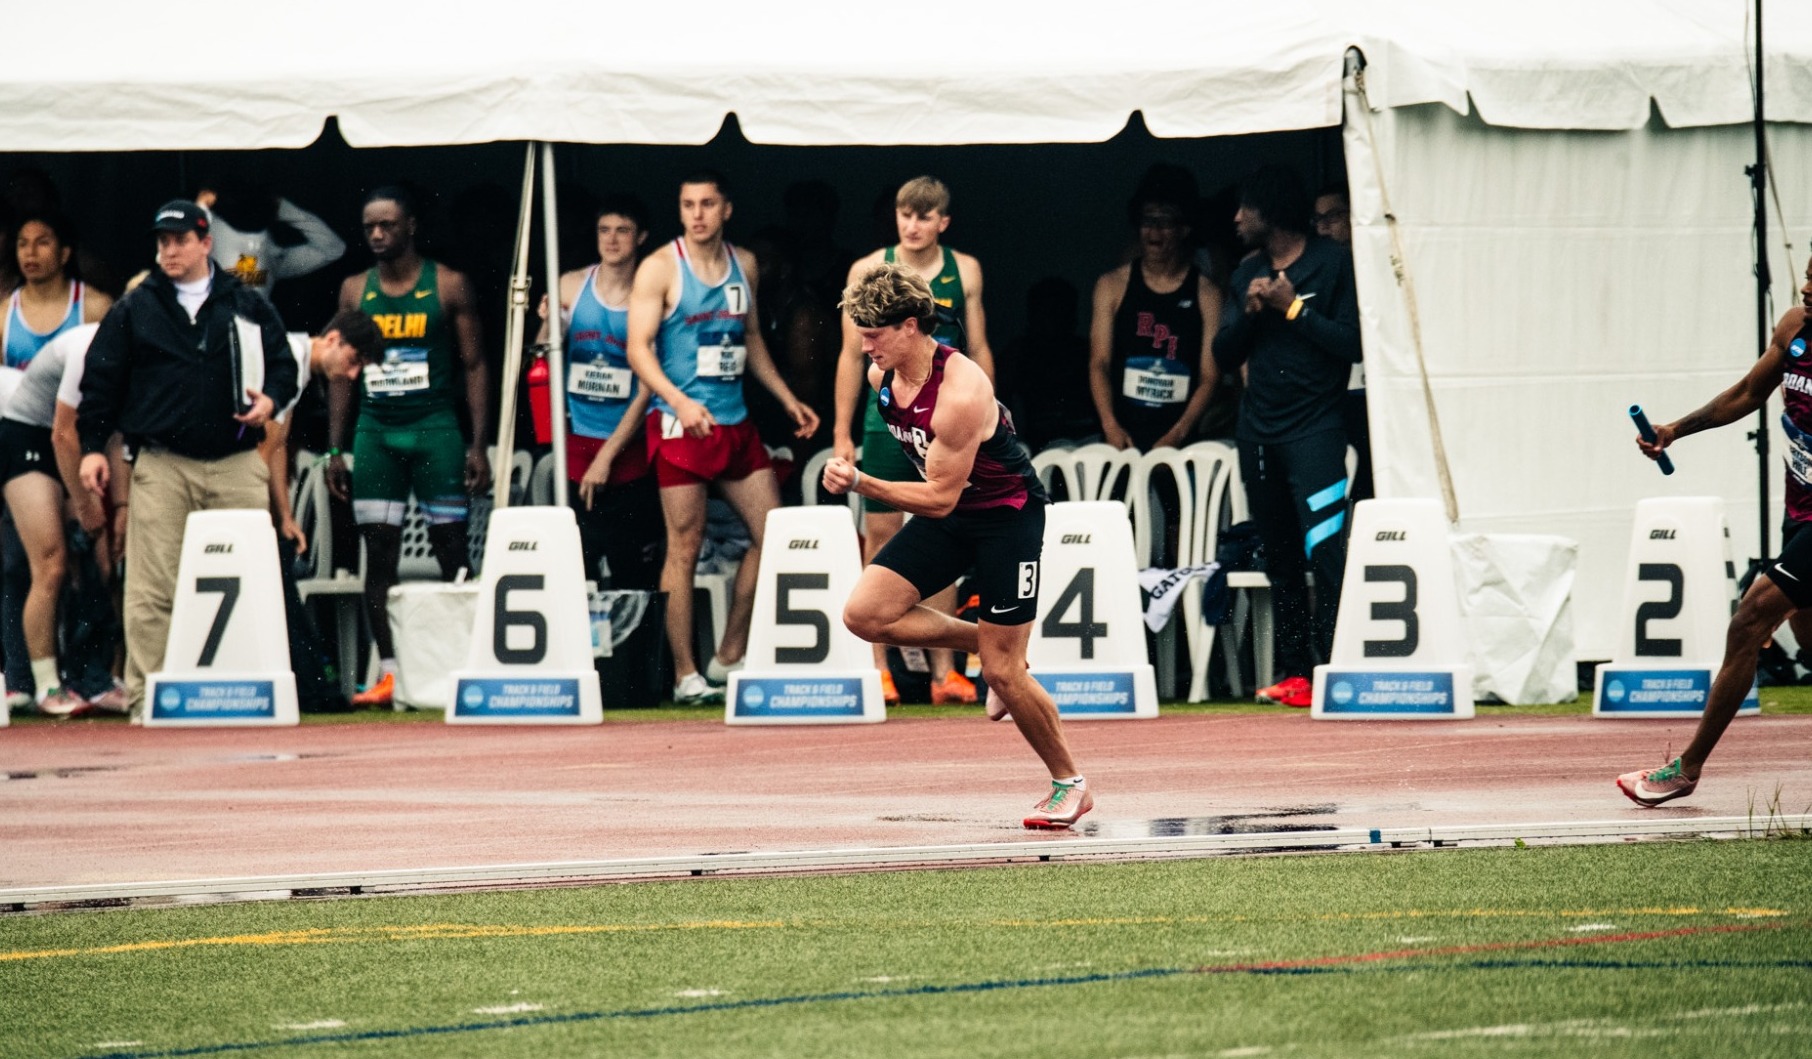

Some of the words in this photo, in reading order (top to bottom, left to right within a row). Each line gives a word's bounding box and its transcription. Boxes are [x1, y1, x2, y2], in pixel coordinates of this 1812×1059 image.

[730, 286, 741, 312] 7
[1136, 311, 1178, 360] RPI
[1061, 534, 1092, 544] GILL
[1375, 531, 1406, 541] GILL
[1649, 529, 1677, 540] GILL
[204, 544, 234, 553] GILL
[508, 542, 538, 551] GILL
[788, 540, 819, 550] GILL
[1023, 564, 1034, 597] 3
[1041, 567, 1108, 660] 4
[1363, 564, 1419, 658] 3
[1635, 563, 1684, 657] 2
[196, 577, 241, 668] 7
[493, 575, 548, 665] 6
[775, 573, 830, 664] 5
[488, 695, 574, 709] CHAMPIONSHIPS
[769, 695, 857, 709] CHAMPIONSHIPS
[1052, 692, 1129, 705] AMPIONSHIPS
[1358, 692, 1447, 705] CHAMPIONSHIPS
[1629, 690, 1705, 703] CHAMPIONSHIPS
[185, 697, 269, 711] CHAMPIONSHIPS
